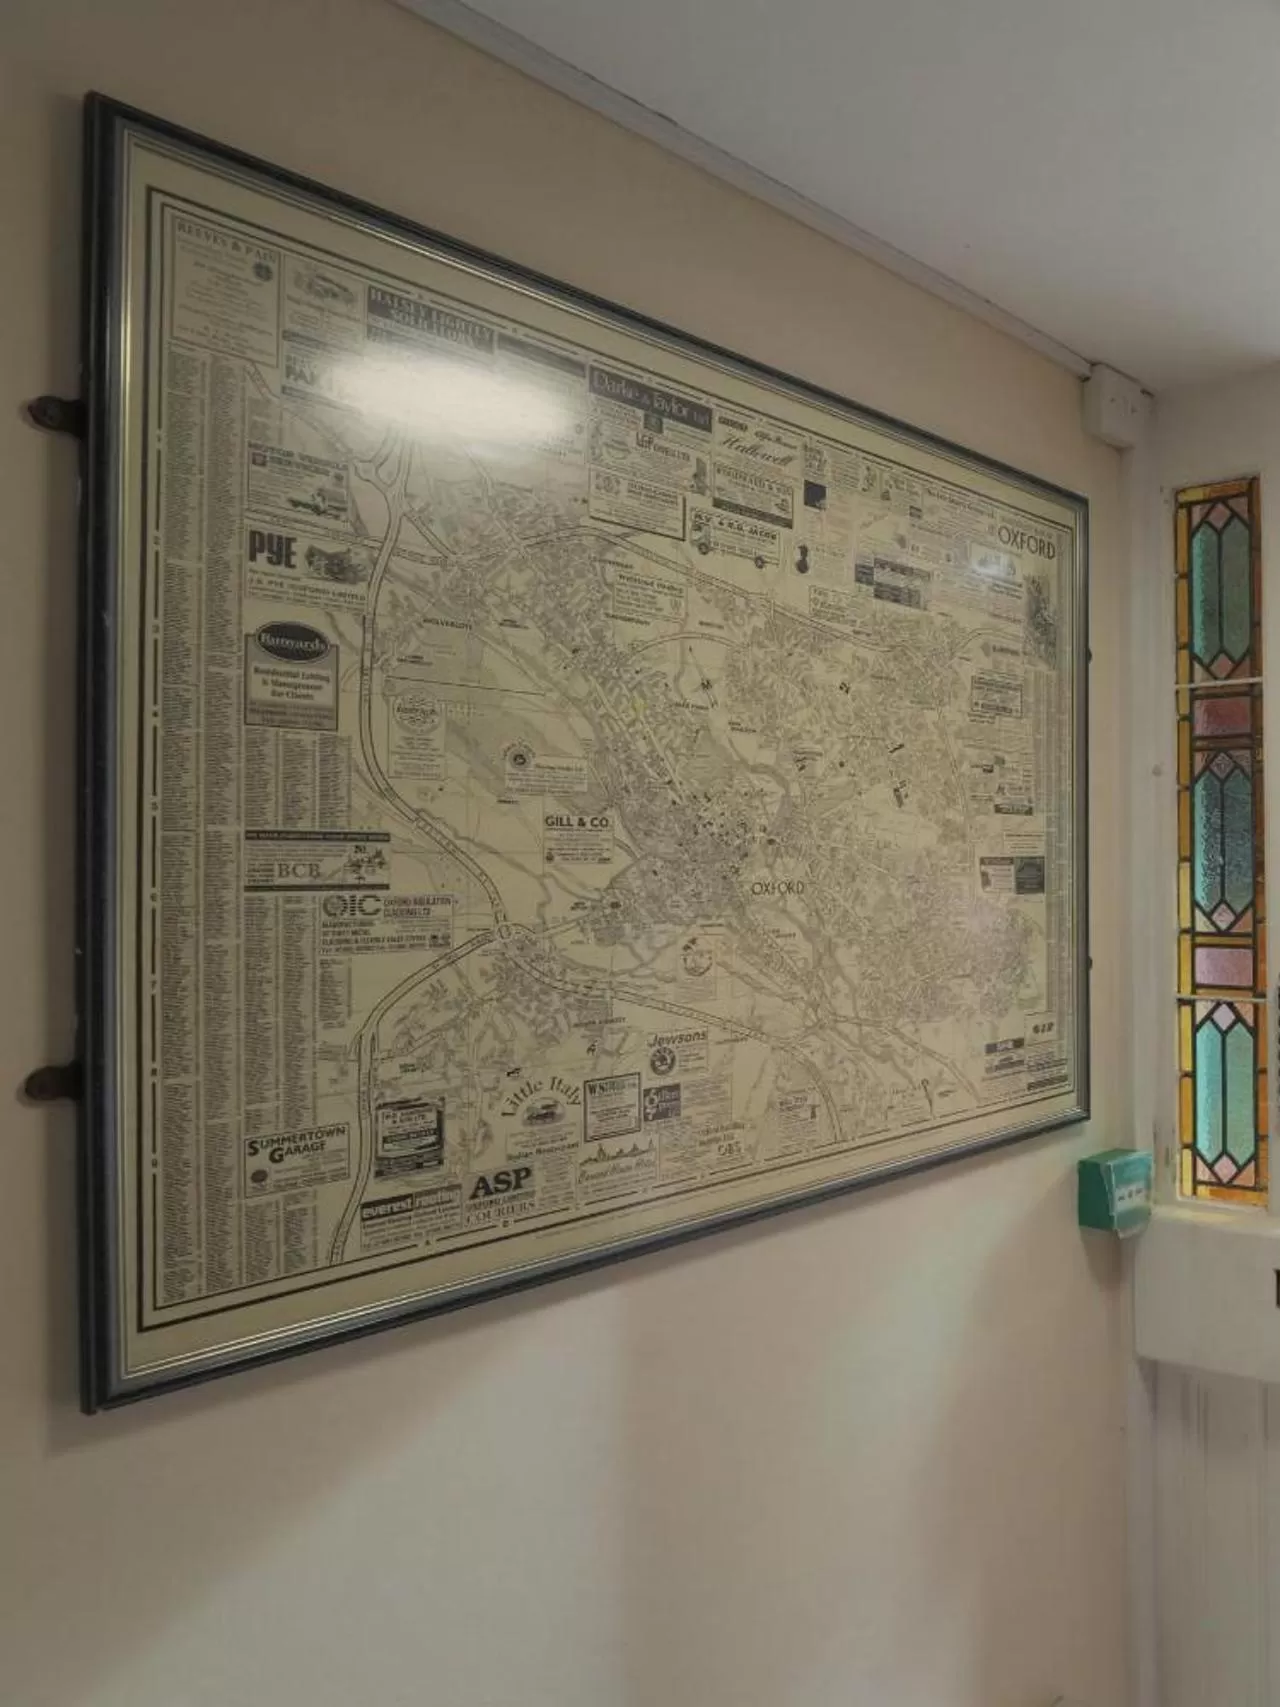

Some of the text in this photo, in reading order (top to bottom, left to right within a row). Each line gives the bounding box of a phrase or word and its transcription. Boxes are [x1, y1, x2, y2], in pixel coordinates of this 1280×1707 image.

[249, 530, 297, 569] PYE
[998, 525, 1056, 560] OXFORD
[545, 815, 573, 828] GILL
[577, 817, 587, 828] &
[277, 863, 321, 880] BCB
[751, 881, 805, 896] OXFORD
[501, 1079, 544, 1117] Little
[549, 1075, 582, 1106] Italy
[247, 1126, 345, 1156] SUMMERTOWN
[268, 1139, 325, 1164] GARAGE
[469, 1166, 533, 1200] ASP
